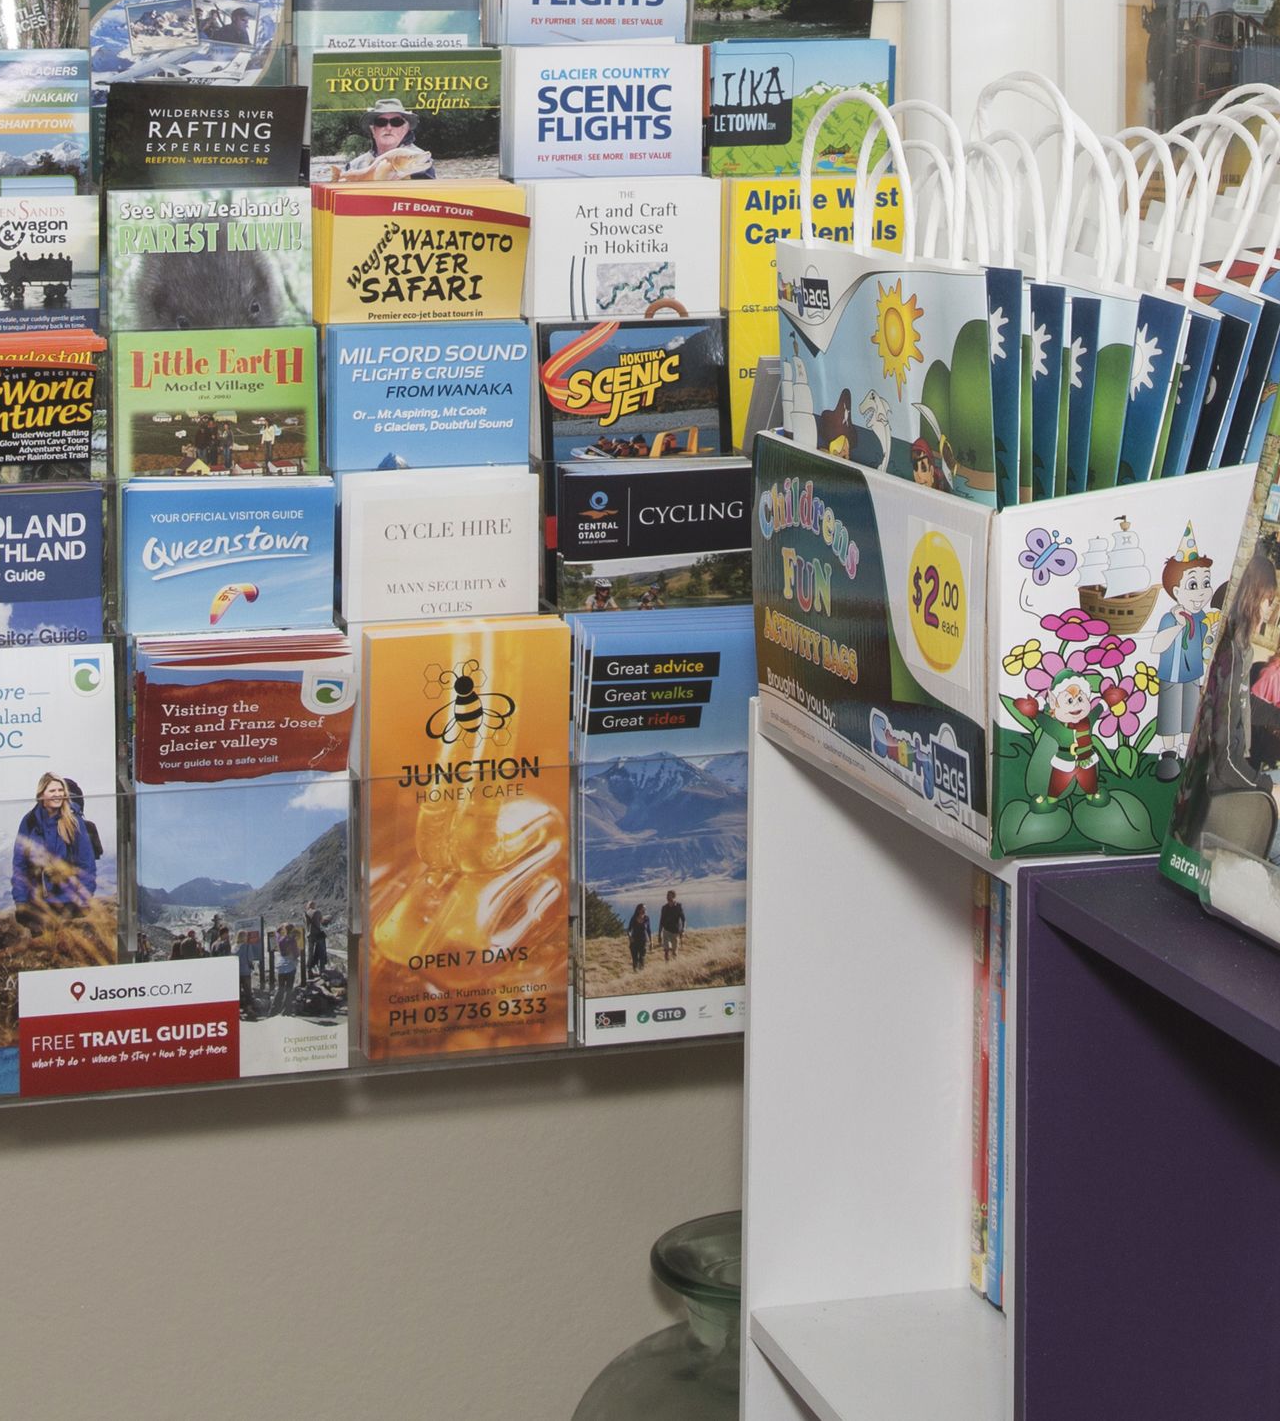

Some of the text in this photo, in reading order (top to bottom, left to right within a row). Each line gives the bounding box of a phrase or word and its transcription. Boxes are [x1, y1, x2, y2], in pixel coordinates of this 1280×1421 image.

[541, 68, 670, 80] GLACIER COUNTRY
[538, 85, 672, 114] SCENIC
[148, 120, 272, 140] RAFTING
[539, 115, 672, 142] FLIGHTS
[837, 188, 898, 208] Wst
[400, 229, 513, 254] WAIATOTO
[384, 254, 469, 275] RIVER
[360, 277, 482, 303] SAFARI
[340, 344, 527, 365] MILFORD SOUND
[151, 510, 304, 523] YOUR OFFICIAL VISITOR GUIDE
[143, 526, 309, 570] Queenstown
[606, 660, 704, 678] Great advice
[398, 756, 540, 789] JUNCTION
[389, 998, 547, 1027] PH 03 736 9333
